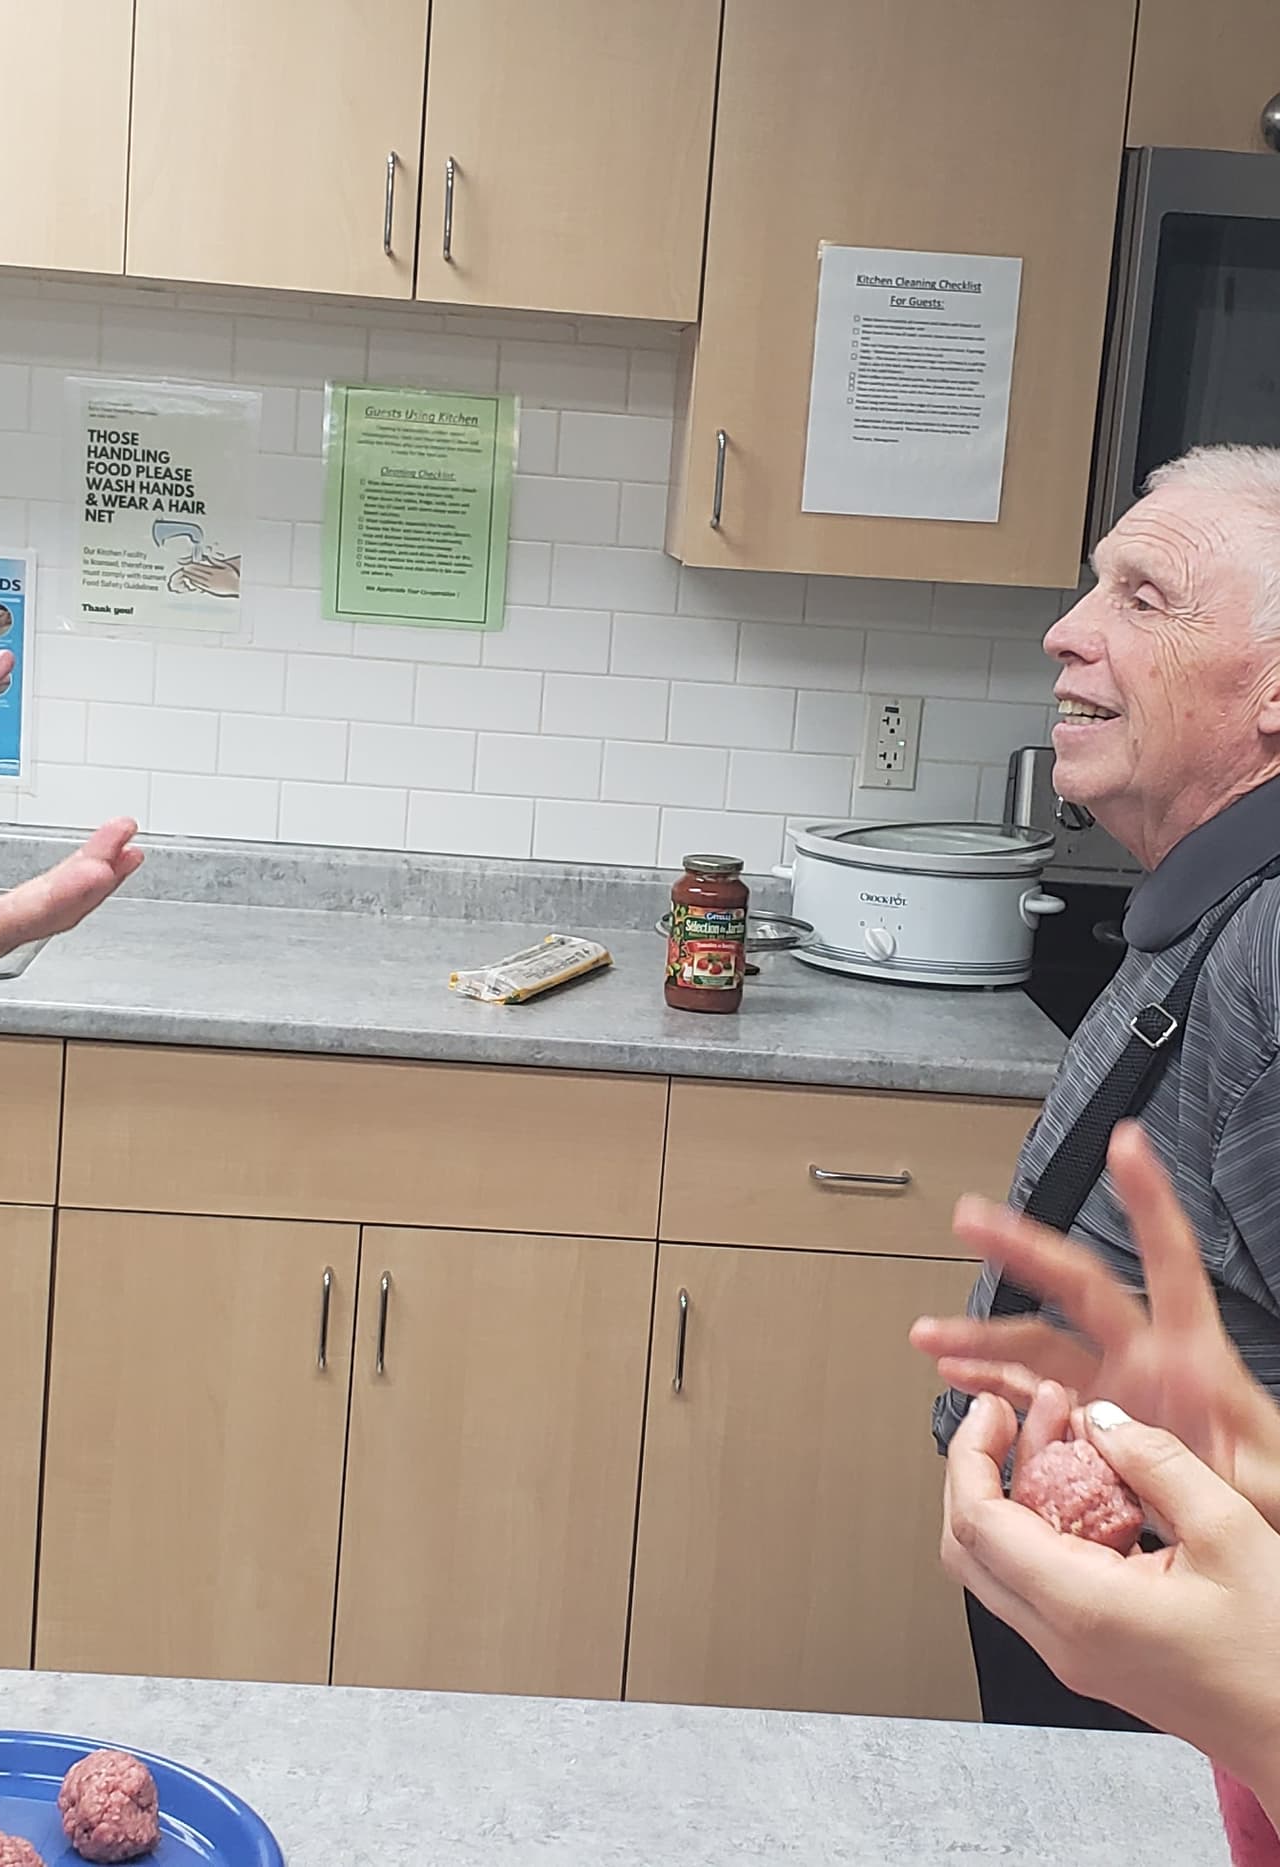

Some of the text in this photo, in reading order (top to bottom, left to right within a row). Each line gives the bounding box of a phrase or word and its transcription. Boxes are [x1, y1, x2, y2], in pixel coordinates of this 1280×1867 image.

[856, 275, 982, 291] Kitchen Cleaning Checklist
[890, 296, 945, 307] For Guests:
[365, 406, 479, 425] Guests Using Kitchen
[87, 429, 140, 446] THOSE
[87, 445, 170, 464] HANDLING
[86, 461, 192, 482] FOOD PLEASE
[86, 477, 195, 498] WASH HANDS
[85, 493, 206, 515] & WEAR A HAIR
[85, 509, 115, 523] NET
[82, 603, 134, 615] Thank you!
